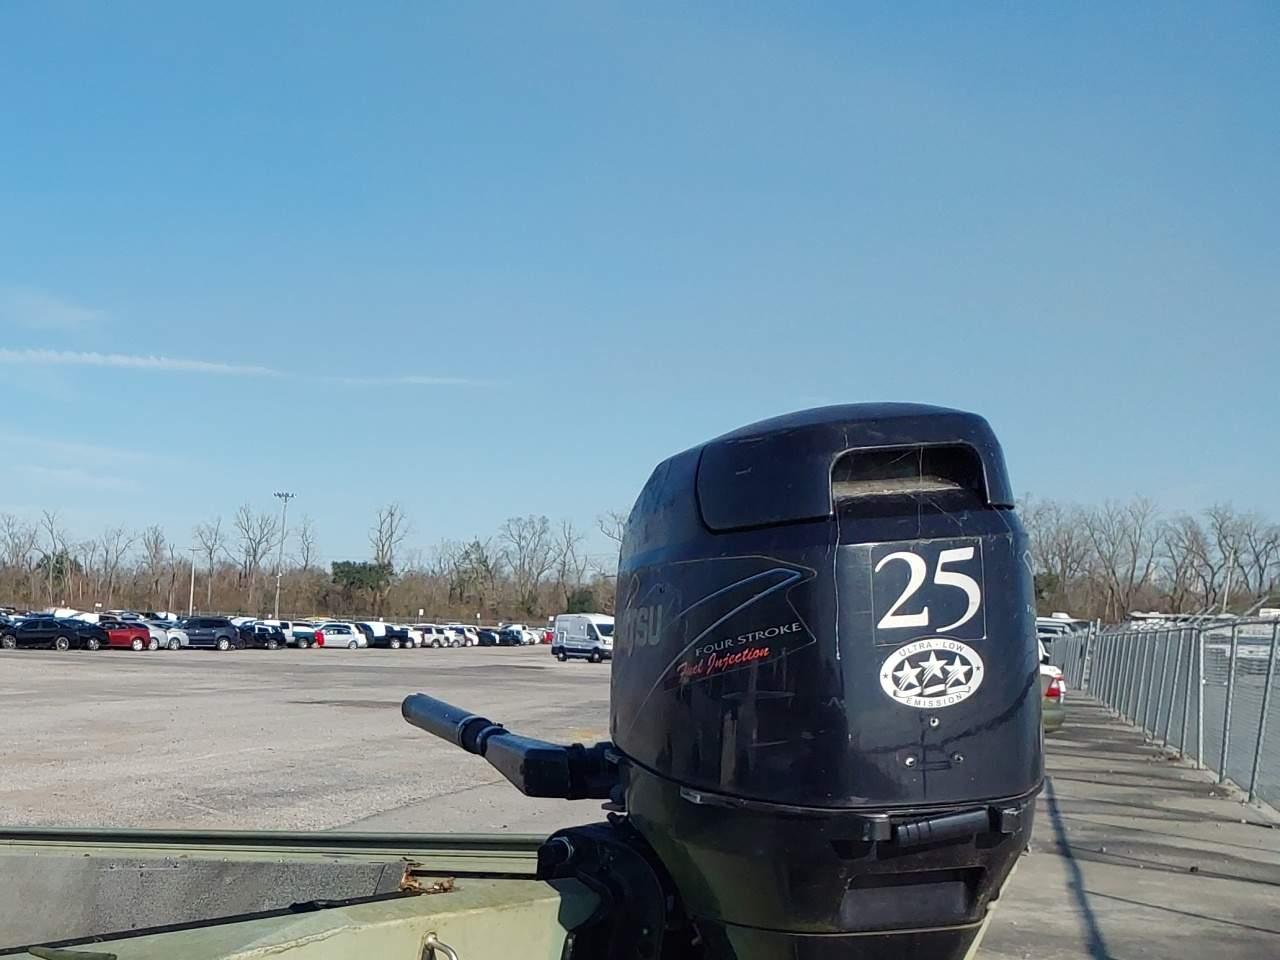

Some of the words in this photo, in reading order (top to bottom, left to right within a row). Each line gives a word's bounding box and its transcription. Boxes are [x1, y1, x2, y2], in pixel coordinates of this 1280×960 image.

[874, 546, 981, 633] 25
[695, 638, 734, 657] FOUR
[737, 622, 802, 646] STROKE
[898, 641, 933, 657] ULTRA
[942, 640, 966, 653] LOW
[676, 660, 705, 679] Fuel
[705, 646, 772, 675] Injection
[906, 692, 963, 708] EMISSION
